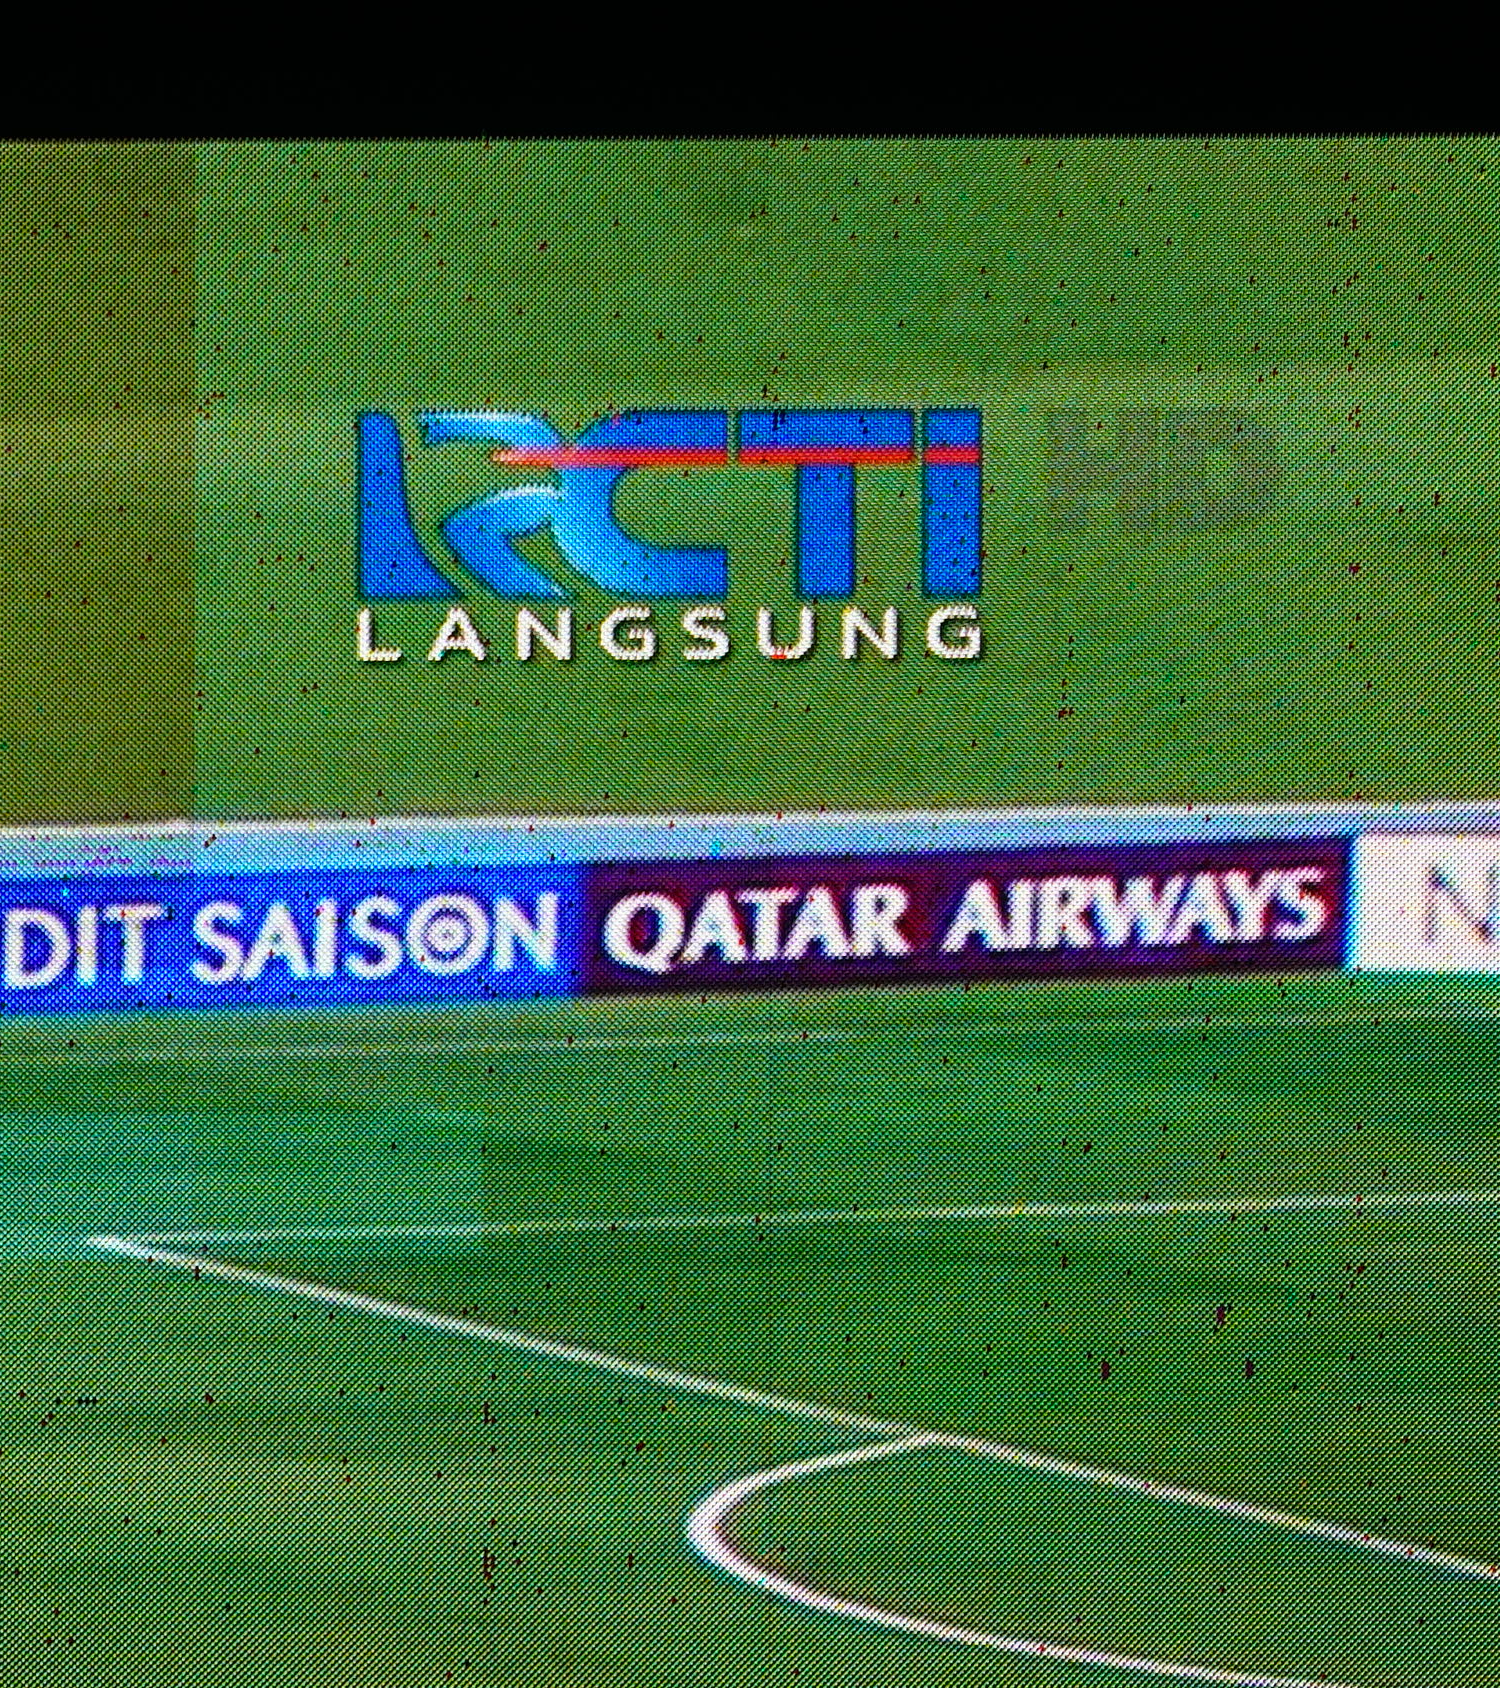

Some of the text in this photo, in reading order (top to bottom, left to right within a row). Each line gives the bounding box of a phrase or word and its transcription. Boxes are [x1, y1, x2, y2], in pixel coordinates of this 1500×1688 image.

[356, 408, 984, 600] RCTI
[356, 607, 984, 664] LANGSUNG
[192, 892, 556, 986] SAISON
[602, 865, 1332, 974] QATAR AIRWAYS
